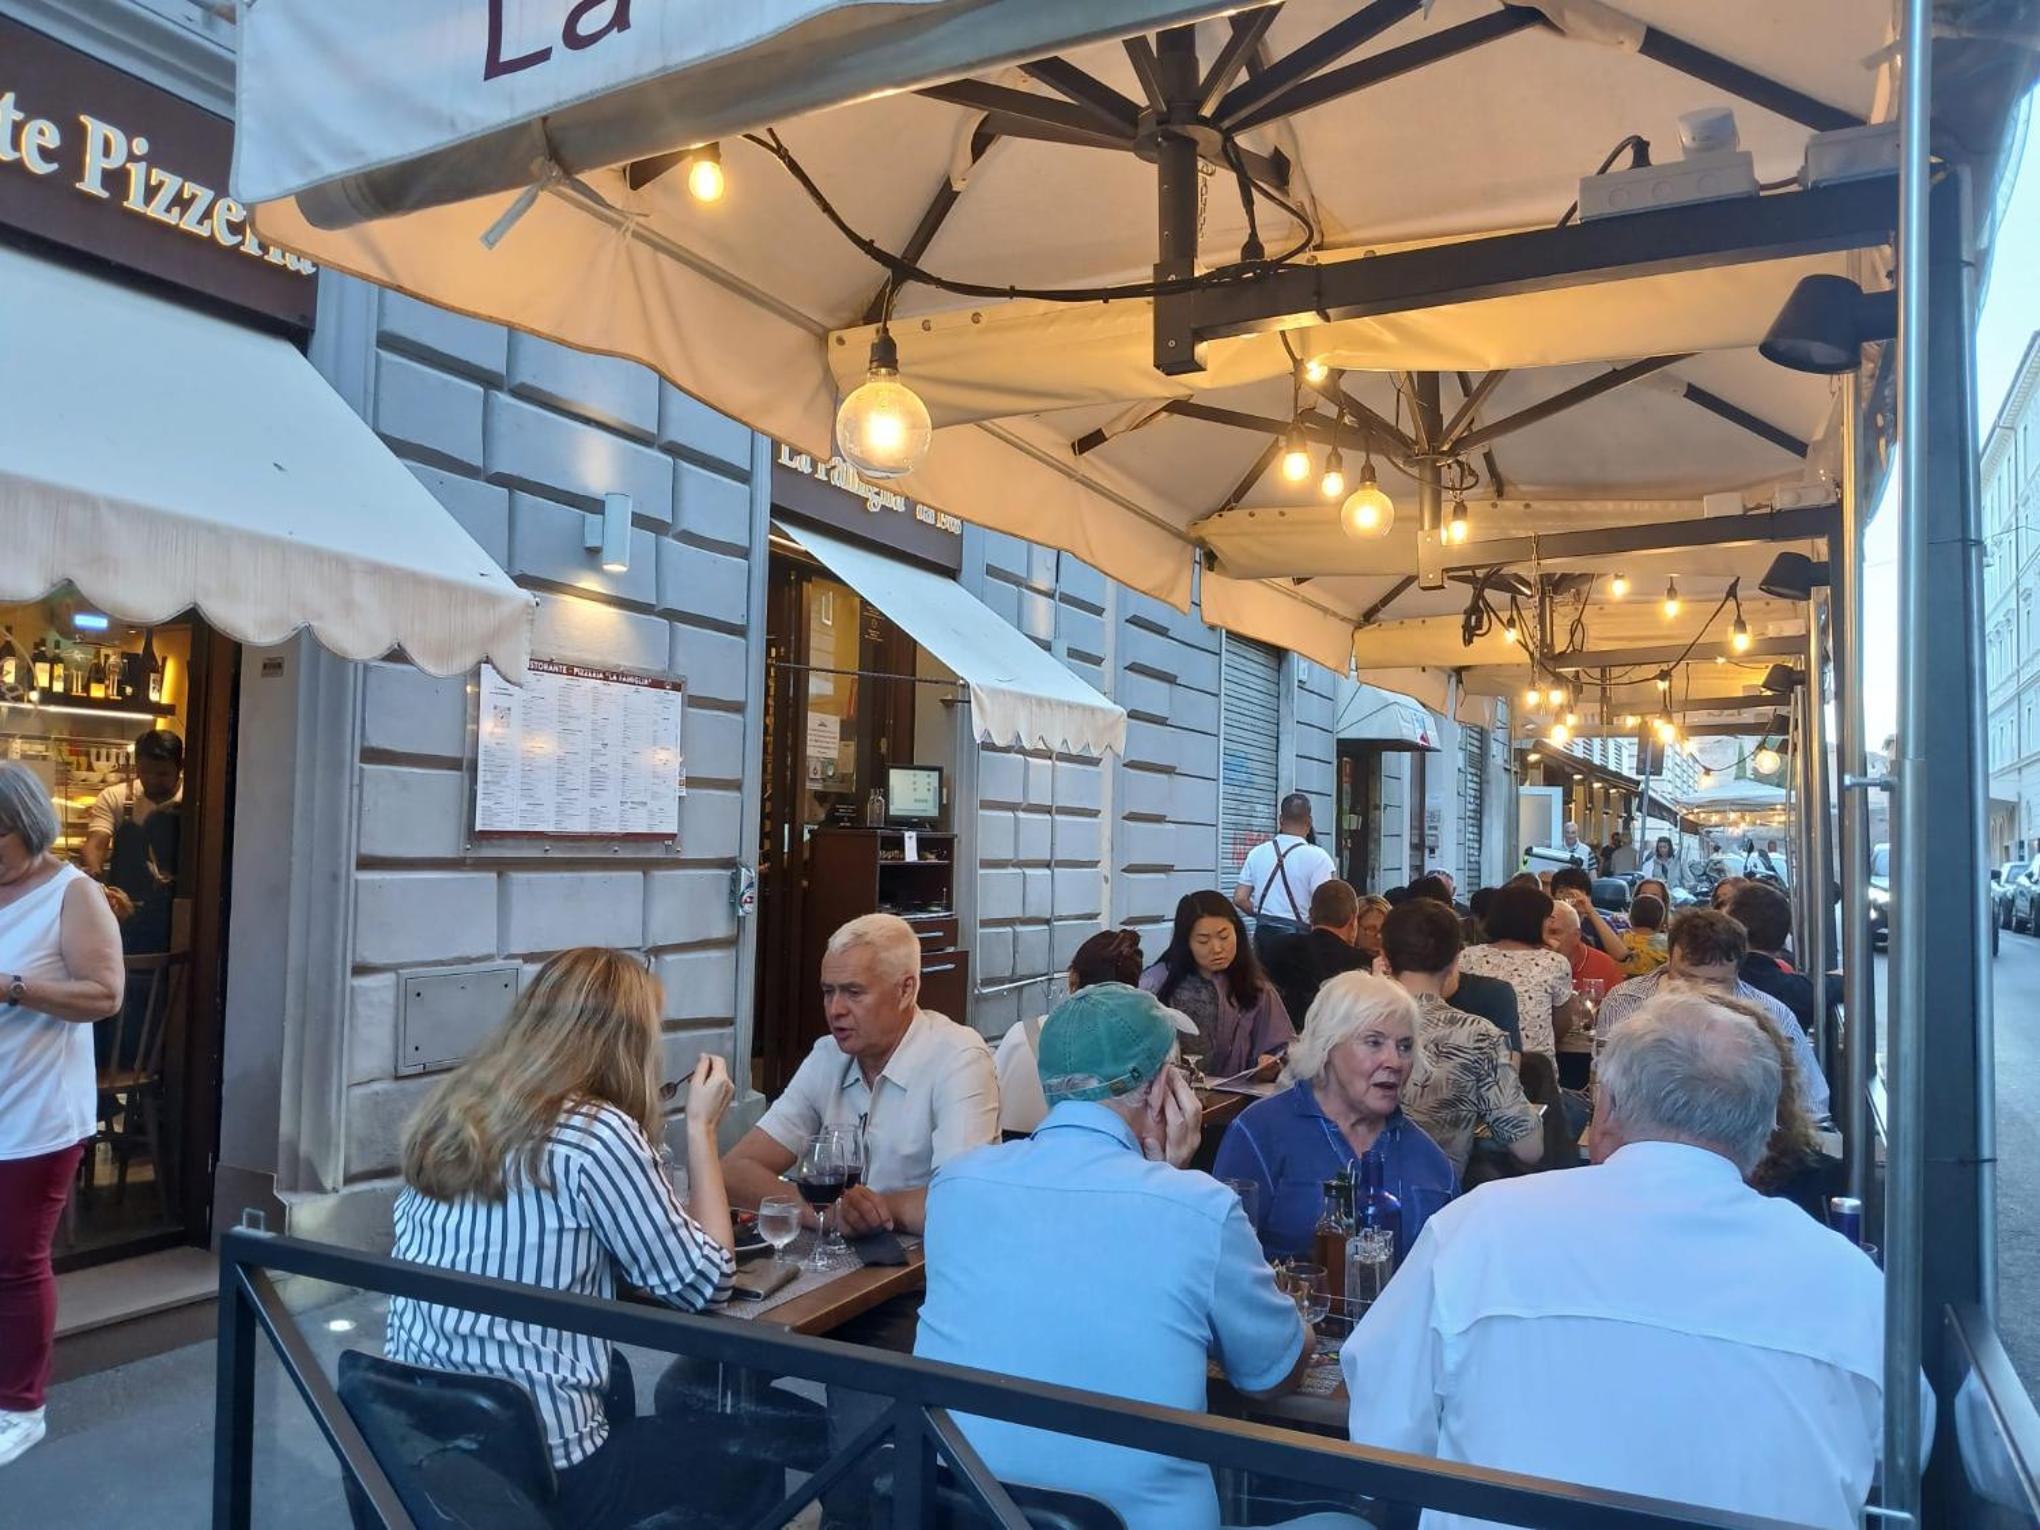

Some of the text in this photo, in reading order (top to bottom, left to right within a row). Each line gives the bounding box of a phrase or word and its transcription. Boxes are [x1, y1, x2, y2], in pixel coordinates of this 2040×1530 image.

[484, 0, 631, 81] La
[75, 113, 317, 275] Pizze
[777, 443, 813, 475] La
